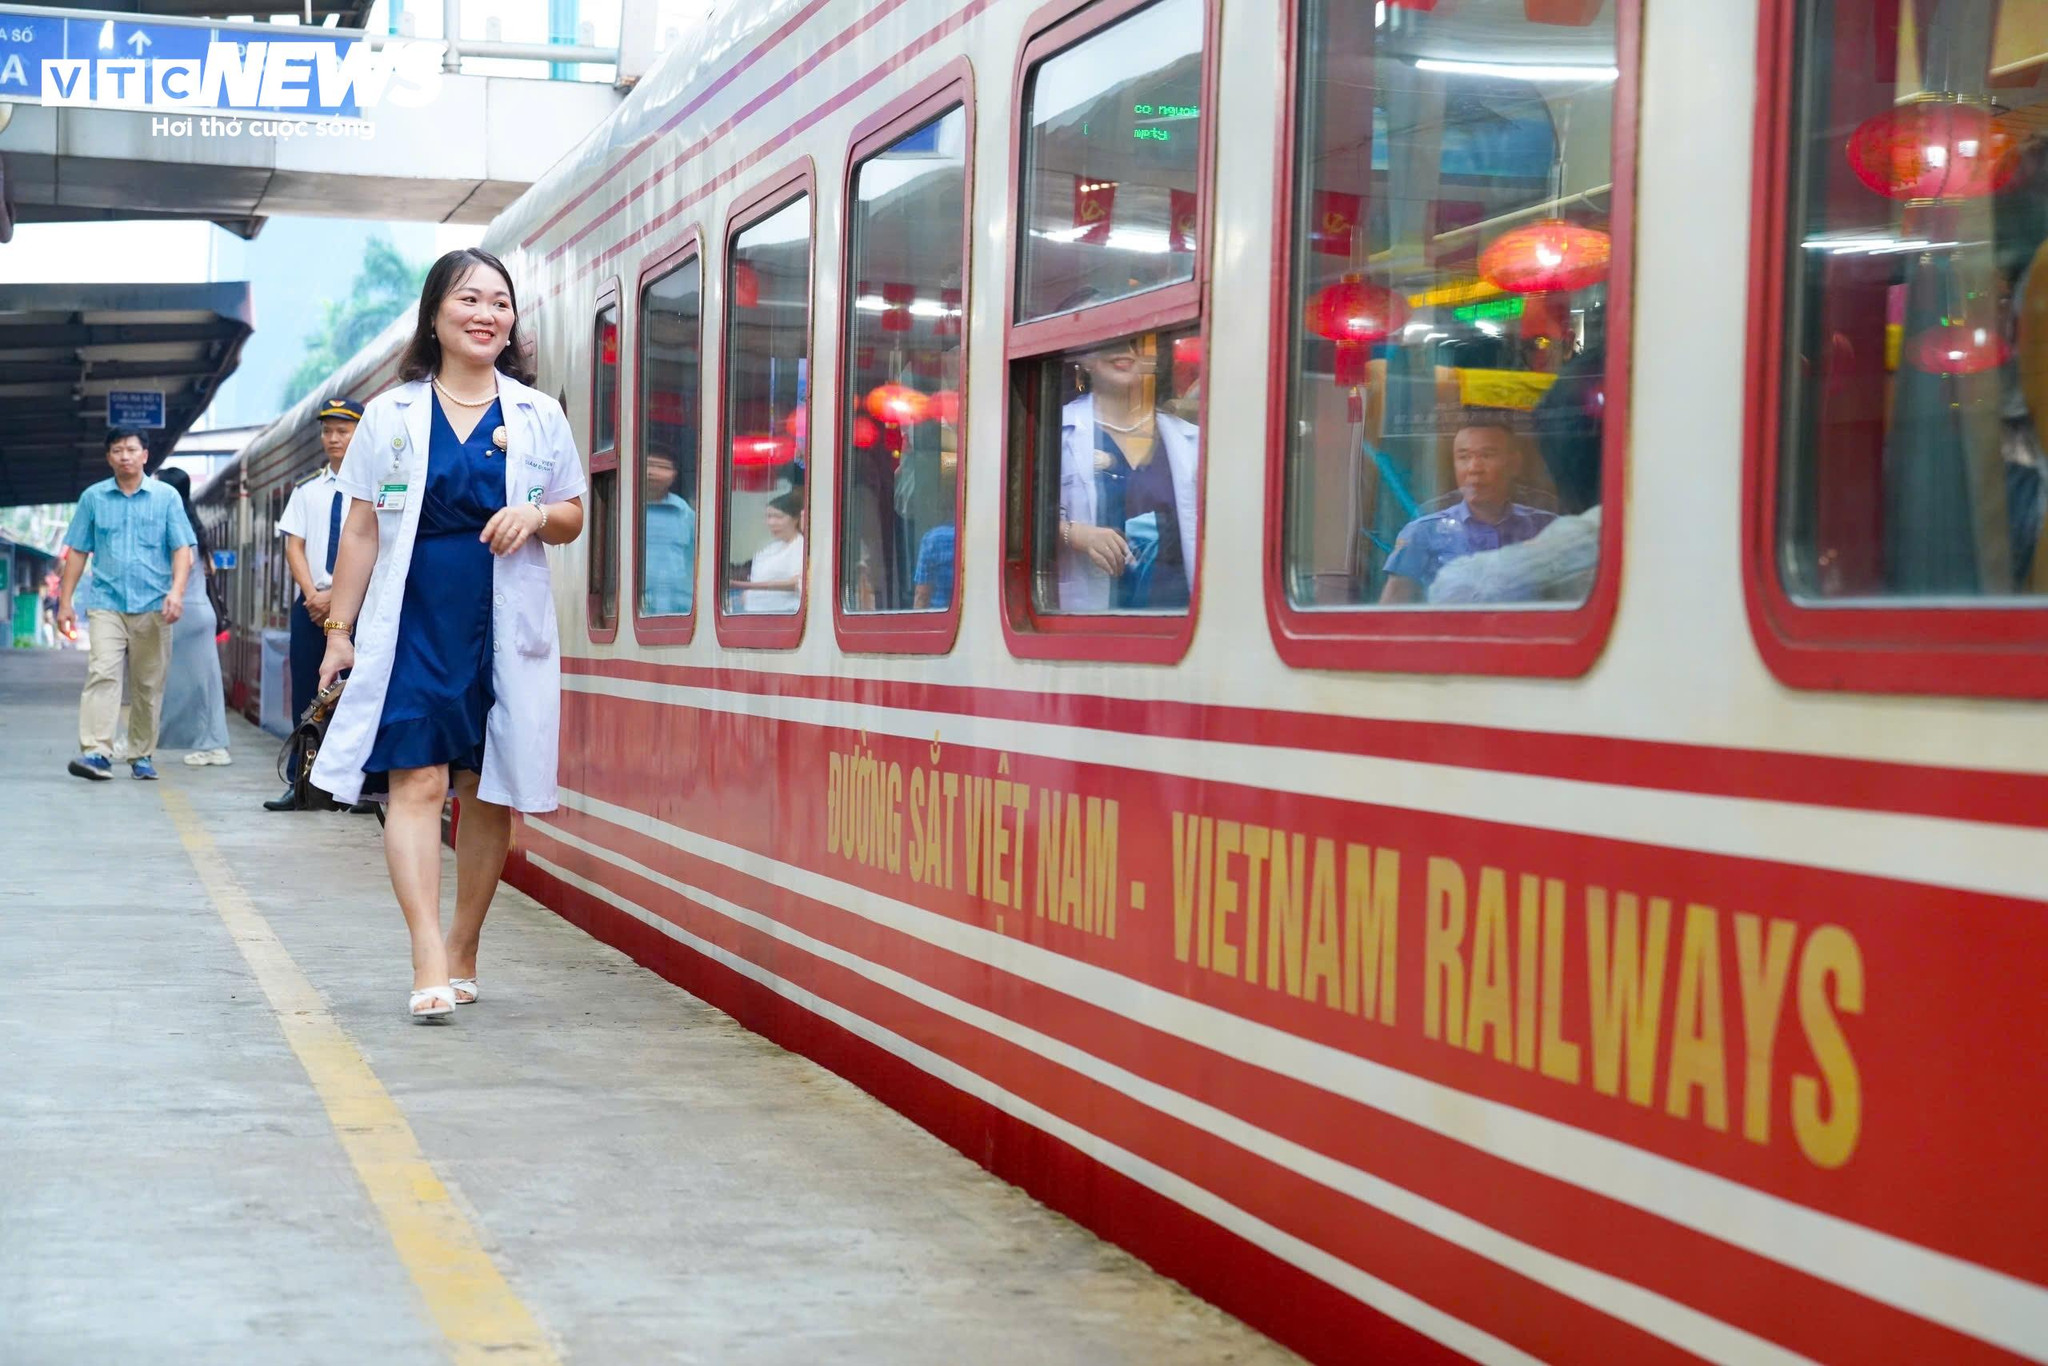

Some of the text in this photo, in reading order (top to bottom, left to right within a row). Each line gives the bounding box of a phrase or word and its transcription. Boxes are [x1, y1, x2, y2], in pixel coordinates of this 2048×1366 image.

[11, 25, 35, 43] SỐ
[827, 728, 1864, 1169] ĐƯỜNG SẮT VIỆT NAM - VIETNAM RAILWAYS
